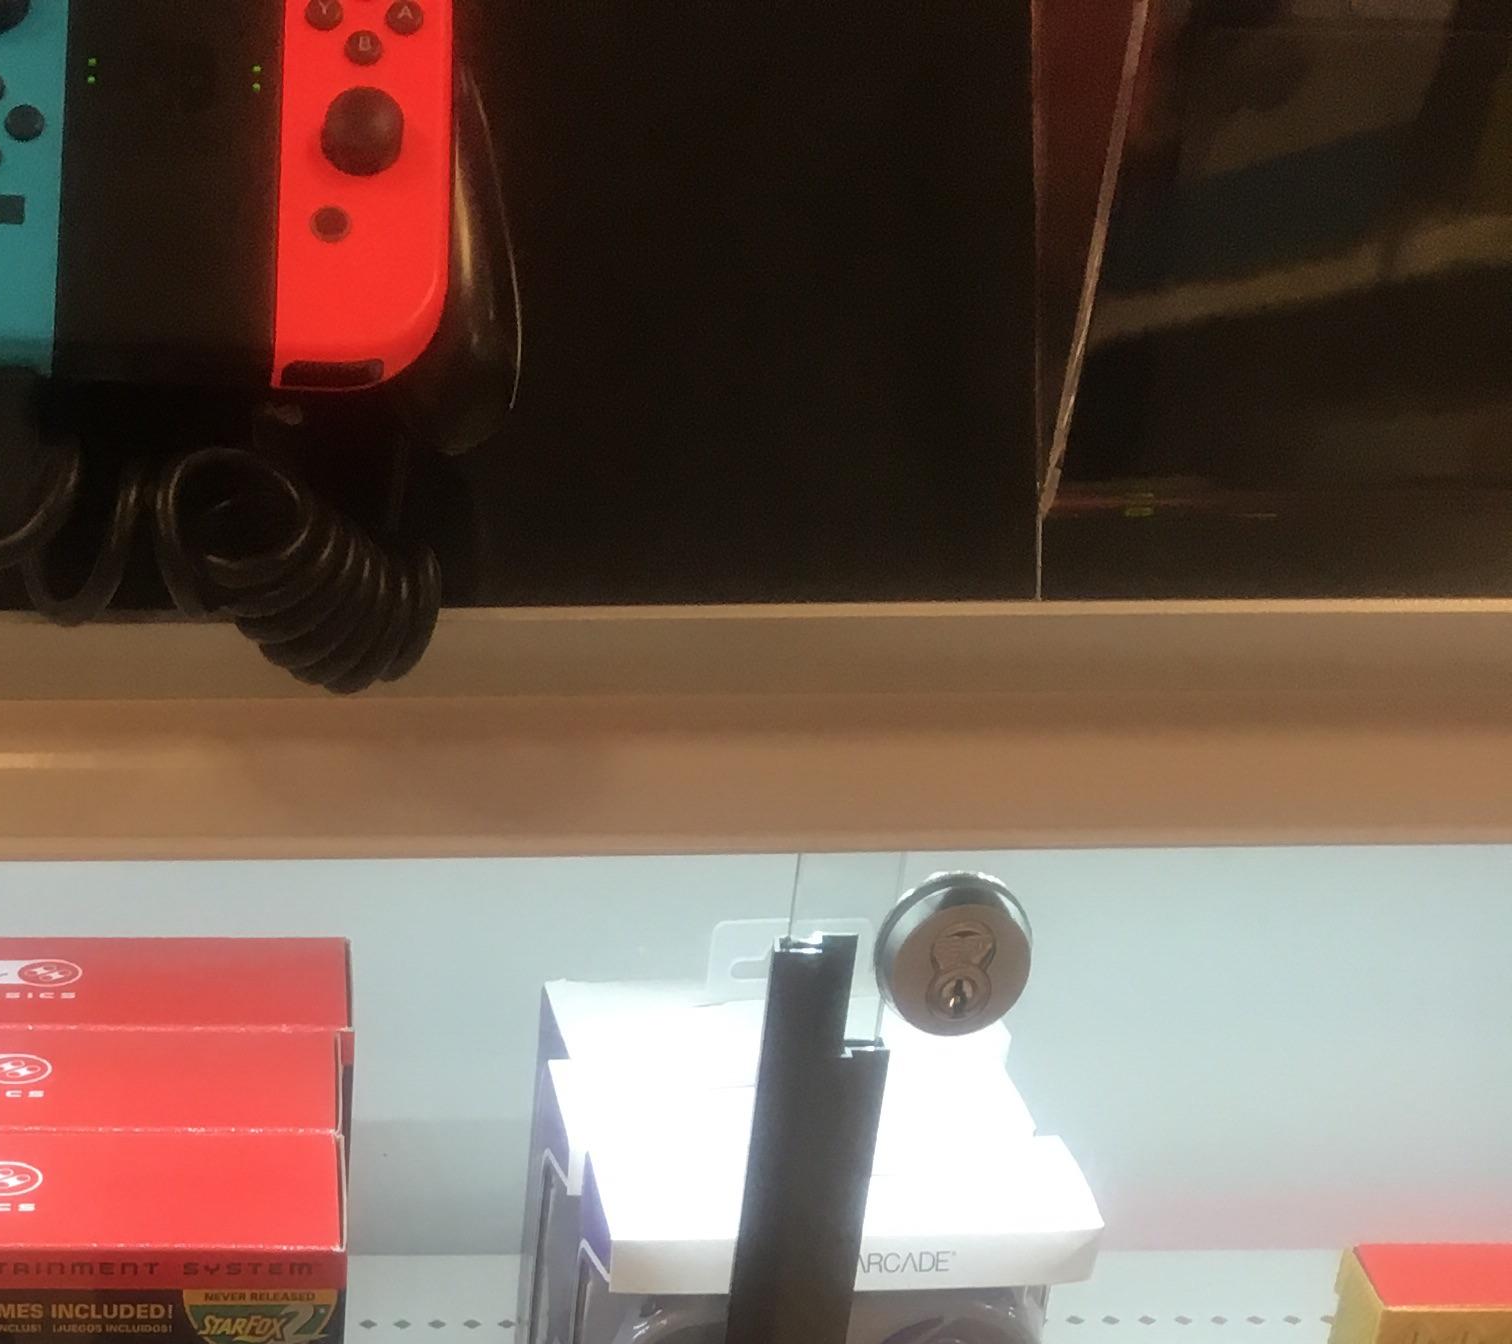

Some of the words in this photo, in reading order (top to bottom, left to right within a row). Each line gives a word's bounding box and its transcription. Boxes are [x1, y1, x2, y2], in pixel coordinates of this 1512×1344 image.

[183, 1261, 314, 1276] SYSTEM
[204, 1291, 246, 1301] NEVER
[250, 1291, 316, 1301] RELEASED
[51, 1303, 173, 1320] INCLUDED!
